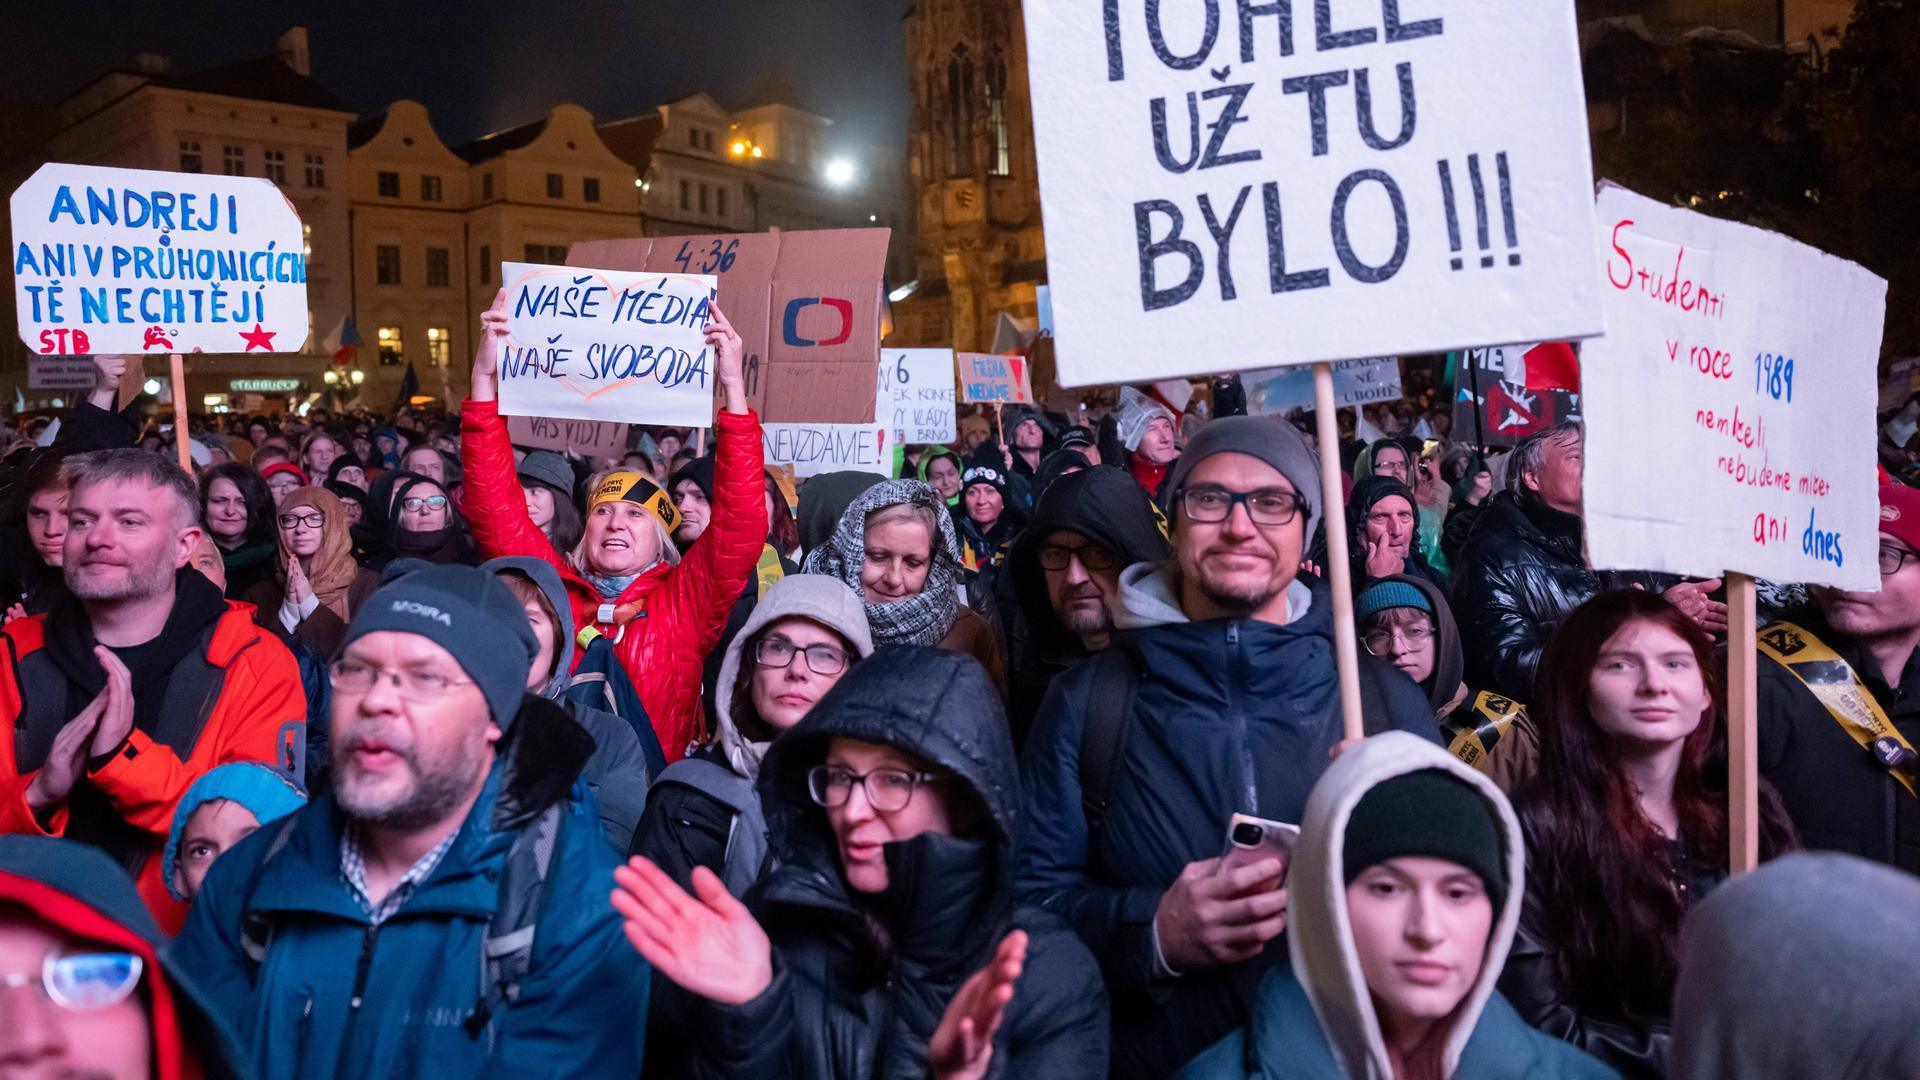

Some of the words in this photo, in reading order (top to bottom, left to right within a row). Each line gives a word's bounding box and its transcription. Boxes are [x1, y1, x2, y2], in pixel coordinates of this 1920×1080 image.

[1150, 65, 1262, 174] UŽ
[1282, 62, 1416, 156] TU
[48, 185, 238, 235] ANDREJI
[15, 241, 77, 277] ANI
[83, 244, 103, 277] V
[112, 234, 307, 283] PRŮHONICÍCH
[675, 239, 740, 274] 4:36
[1133, 168, 1410, 312] BYLO
[1608, 219, 1725, 319] Studenti
[24, 279, 65, 323] TĚ
[79, 281, 265, 324] NECHTĚJÍ
[515, 275, 608, 318] NAŠE
[40, 327, 91, 355] STB
[501, 334, 572, 381] NAŠE
[579, 342, 709, 389] SVOBODA
[896, 354, 910, 384] 6
[1665, 339, 1679, 361] v
[1690, 345, 1733, 379] roce
[1755, 352, 1794, 403] 1989
[917, 429, 949, 441] BRNO
[1718, 447, 1792, 491] nebudeme
[1754, 513, 1788, 546] ani
[1802, 507, 1843, 567] dnes
